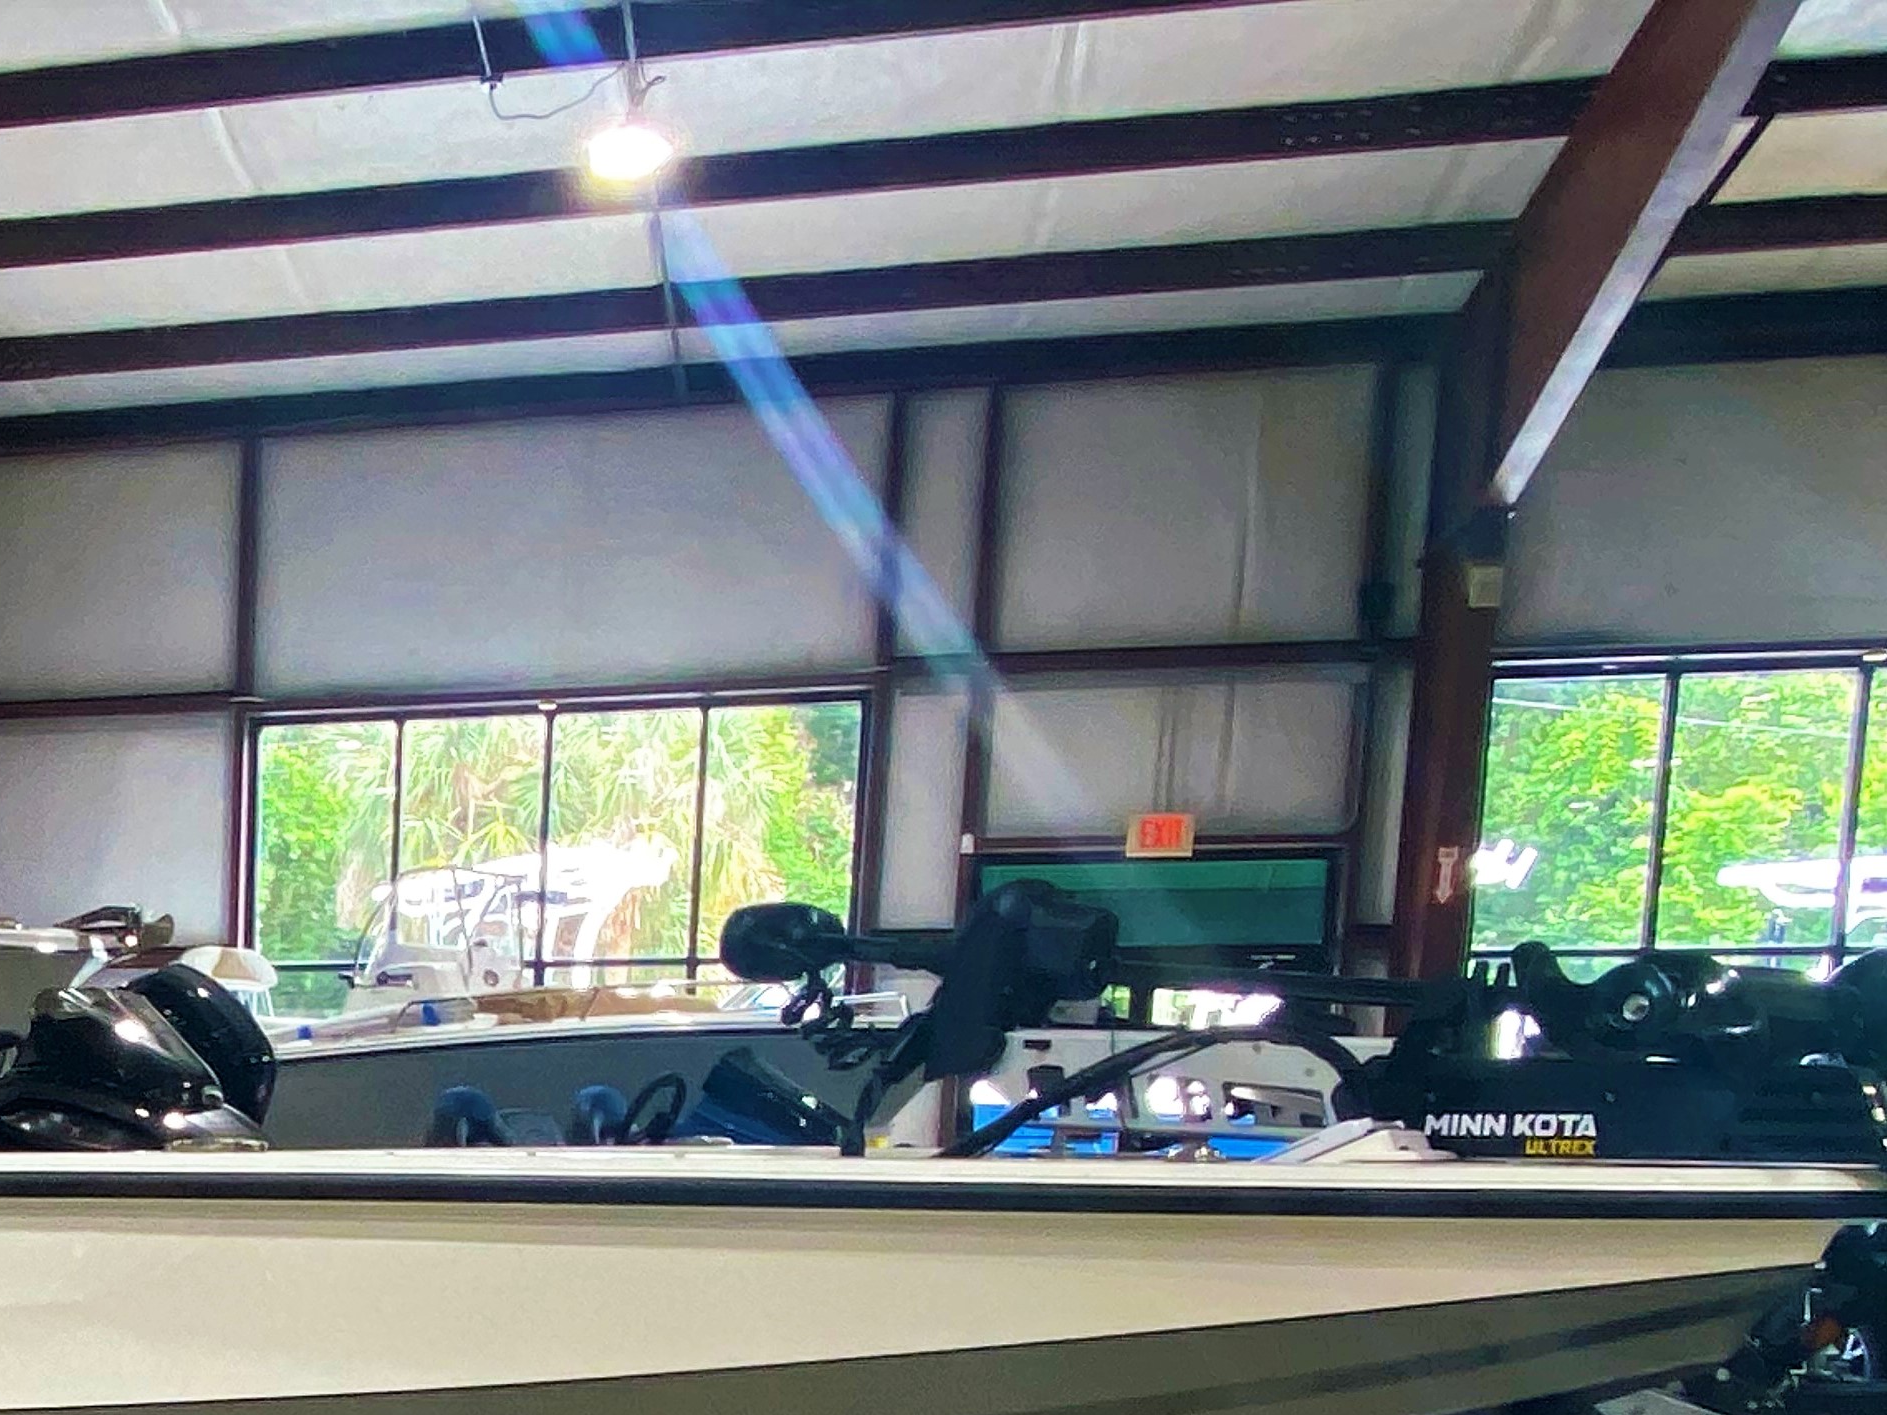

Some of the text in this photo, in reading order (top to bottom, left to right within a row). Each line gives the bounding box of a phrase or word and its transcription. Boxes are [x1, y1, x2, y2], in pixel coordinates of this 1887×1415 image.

[1425, 1113, 1597, 1137] MINN KOTA
[1525, 1139, 1595, 1155] ULTREX
